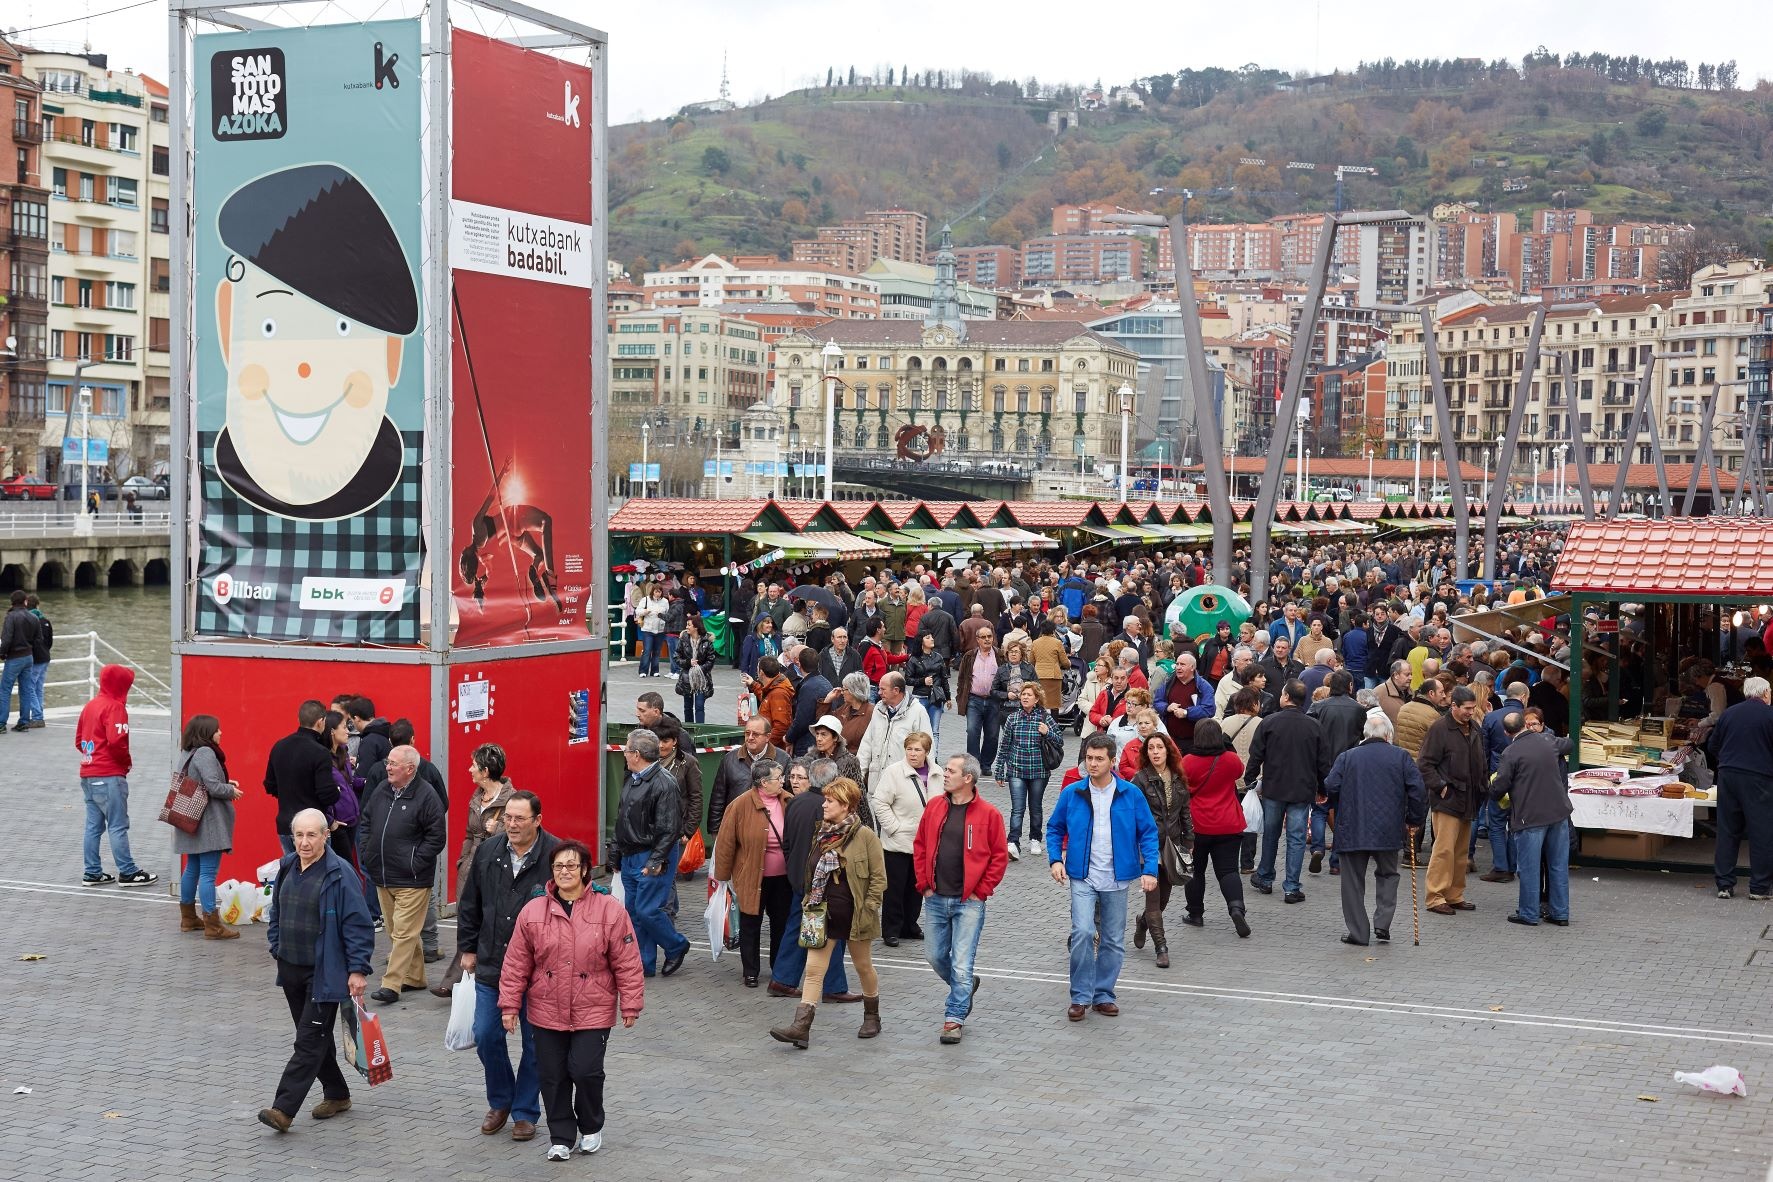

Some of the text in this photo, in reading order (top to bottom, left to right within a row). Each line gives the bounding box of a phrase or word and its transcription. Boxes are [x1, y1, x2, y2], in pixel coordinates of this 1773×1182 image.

[231, 54, 272, 77] SAN
[231, 73, 281, 96] TOTO
[343, 81, 374, 90] kutxabank
[232, 93, 276, 115] MAS
[217, 112, 282, 135] AZOKA
[508, 217, 582, 252] kutxabank
[507, 243, 568, 275] badabil.
[216, 578, 272, 601] Bilbao
[311, 587, 344, 600] bbk
[115, 723, 129, 734] 79
[372, 1040, 385, 1066] Bilbao
